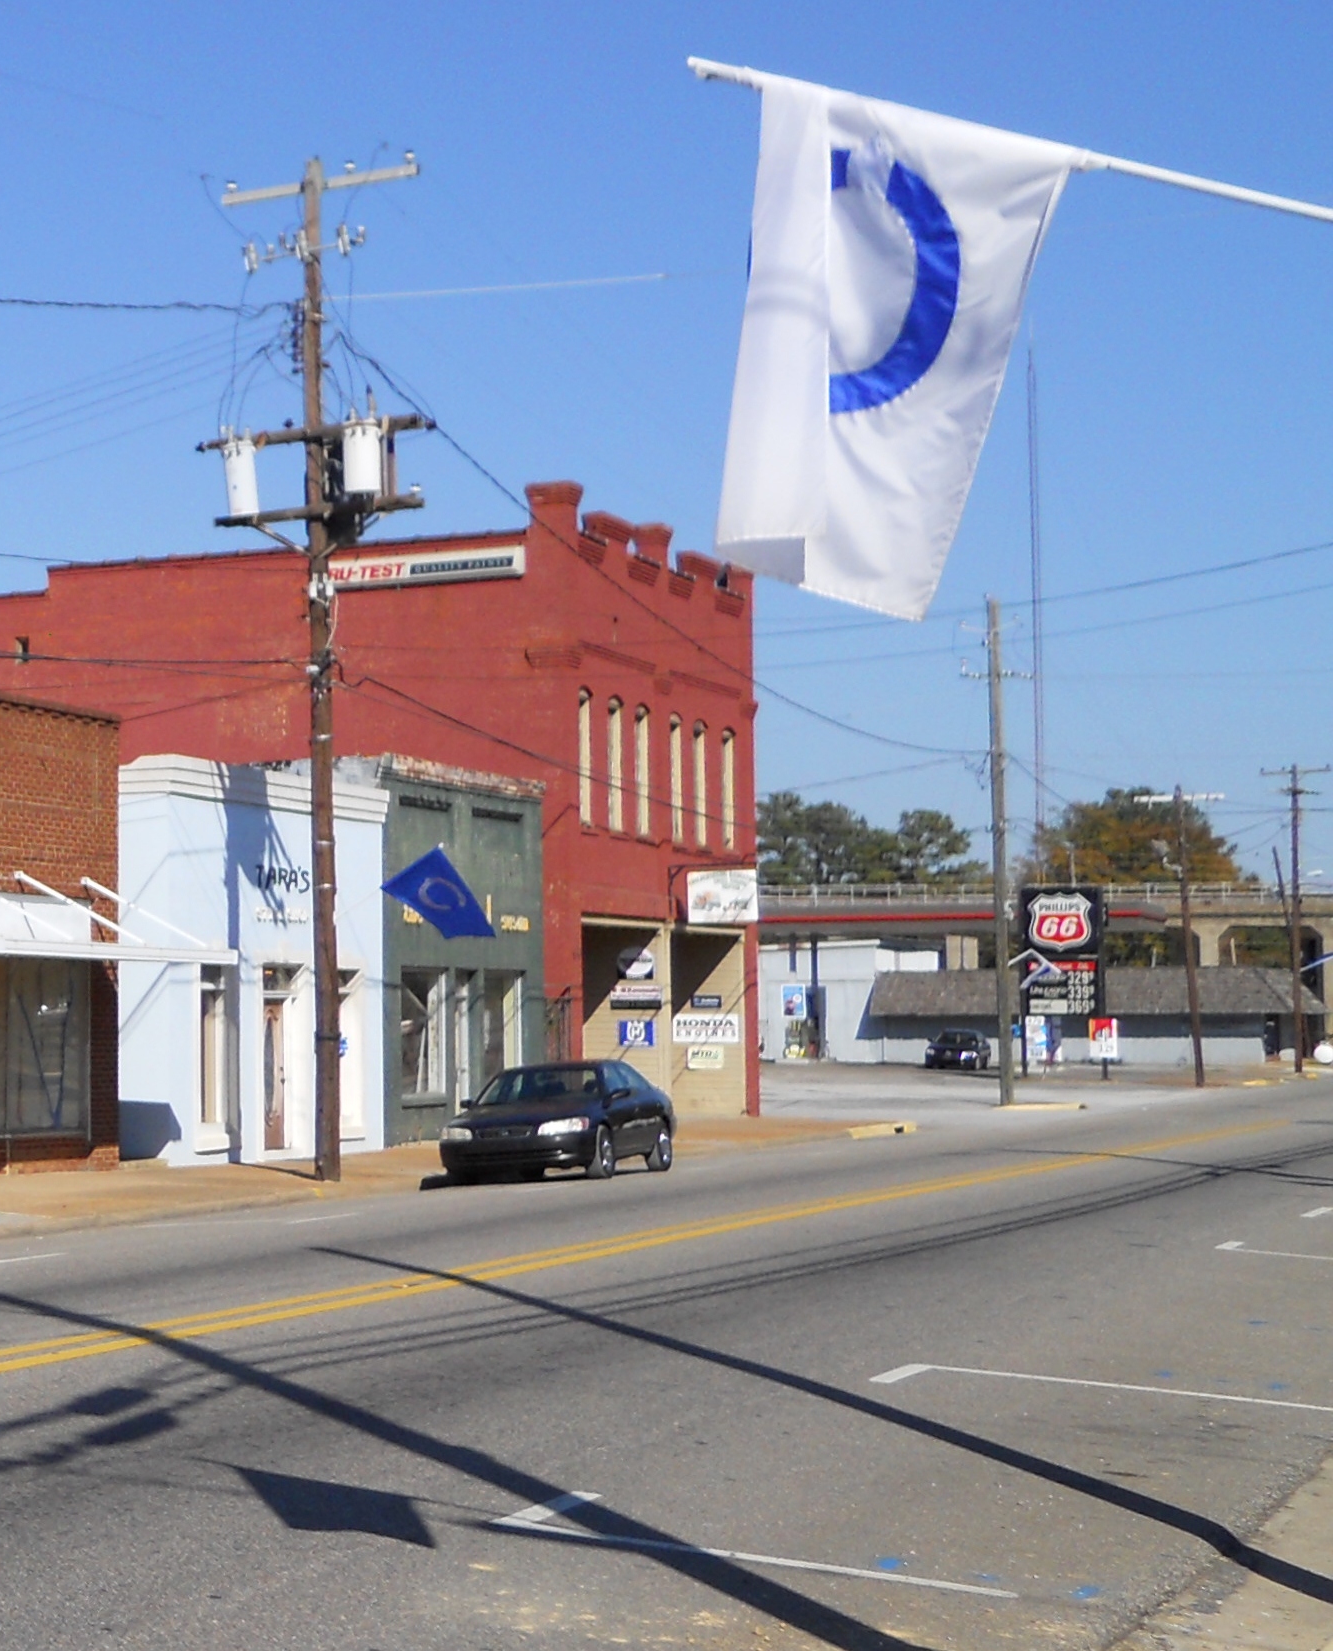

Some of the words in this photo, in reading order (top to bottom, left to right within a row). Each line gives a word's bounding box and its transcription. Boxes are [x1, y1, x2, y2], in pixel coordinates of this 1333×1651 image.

[328, 561, 406, 581] RU-TEST
[255, 864, 310, 893] TARA'S
[1038, 903, 1081, 912] PHILLIPS
[1041, 916, 1079, 937] 66
[675, 1018, 735, 1028] HONDA
[675, 1028, 737, 1038] ENGINES
